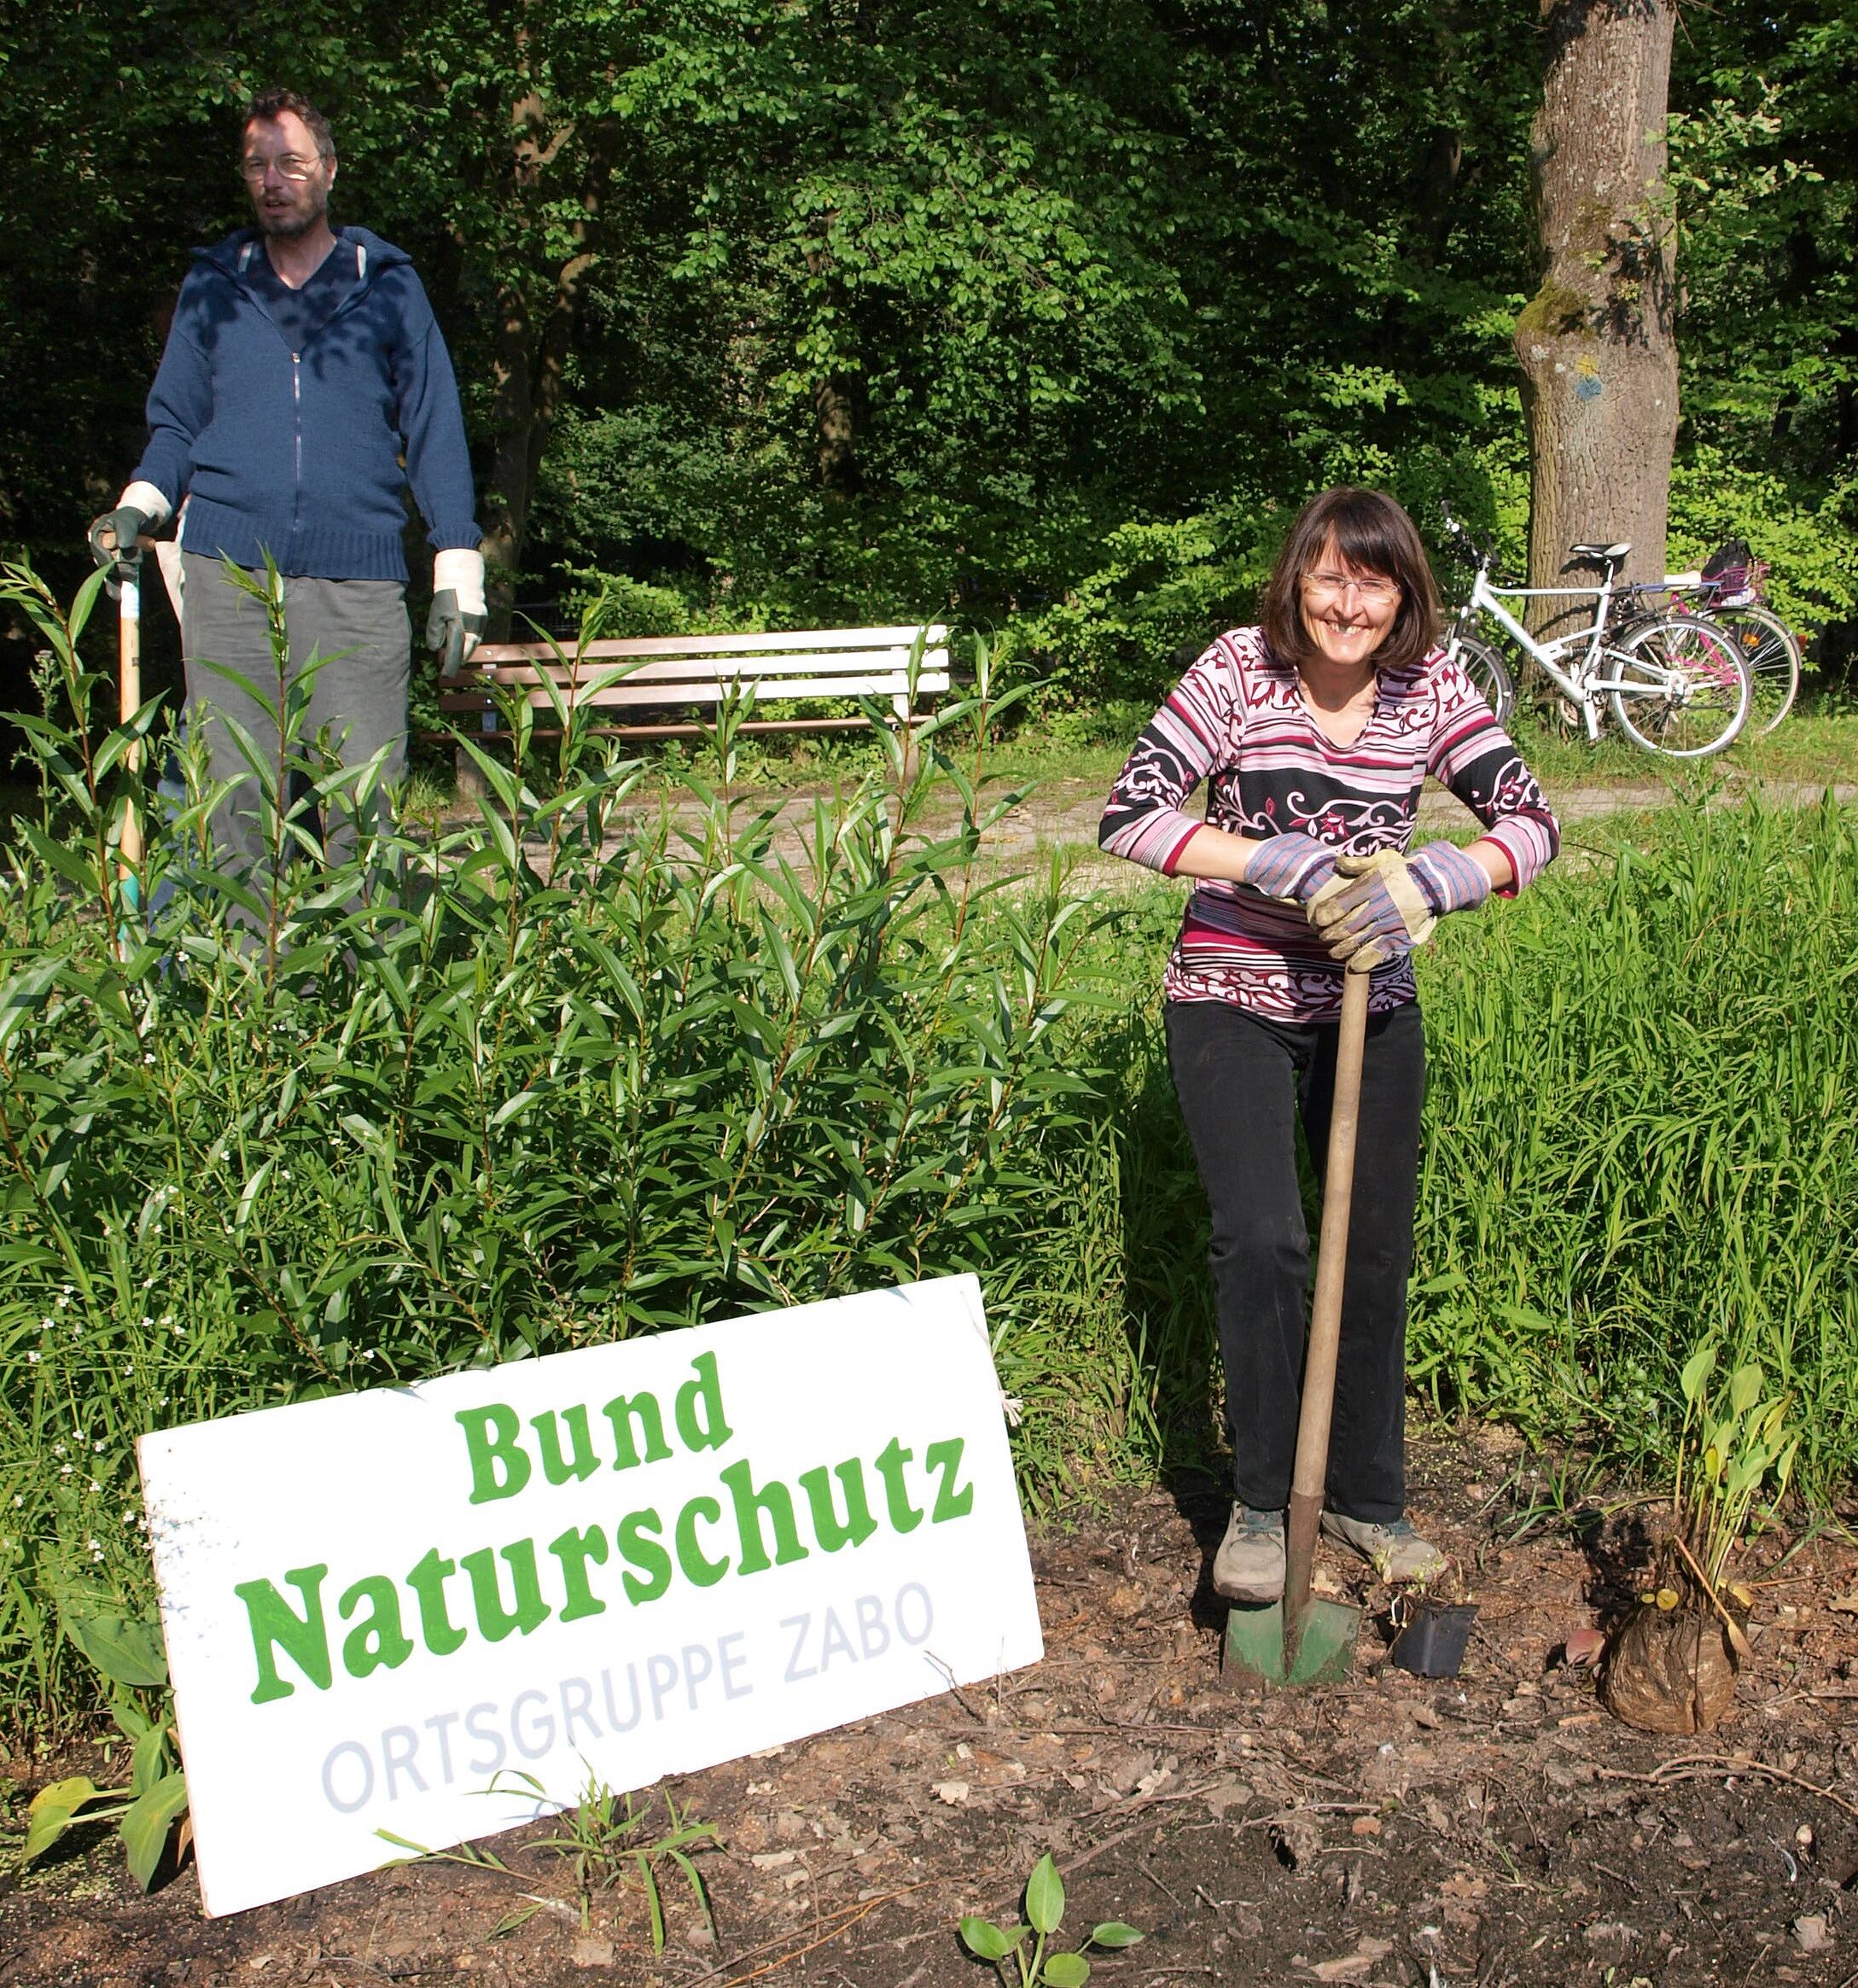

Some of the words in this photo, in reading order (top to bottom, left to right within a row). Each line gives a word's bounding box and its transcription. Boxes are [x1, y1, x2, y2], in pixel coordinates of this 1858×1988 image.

[455, 1352, 732, 1505] Bund
[235, 1438, 973, 1705] Naturschutz
[321, 1631, 754, 1815] ORTSGRUPPE
[780, 1583, 935, 1683] ZABO
